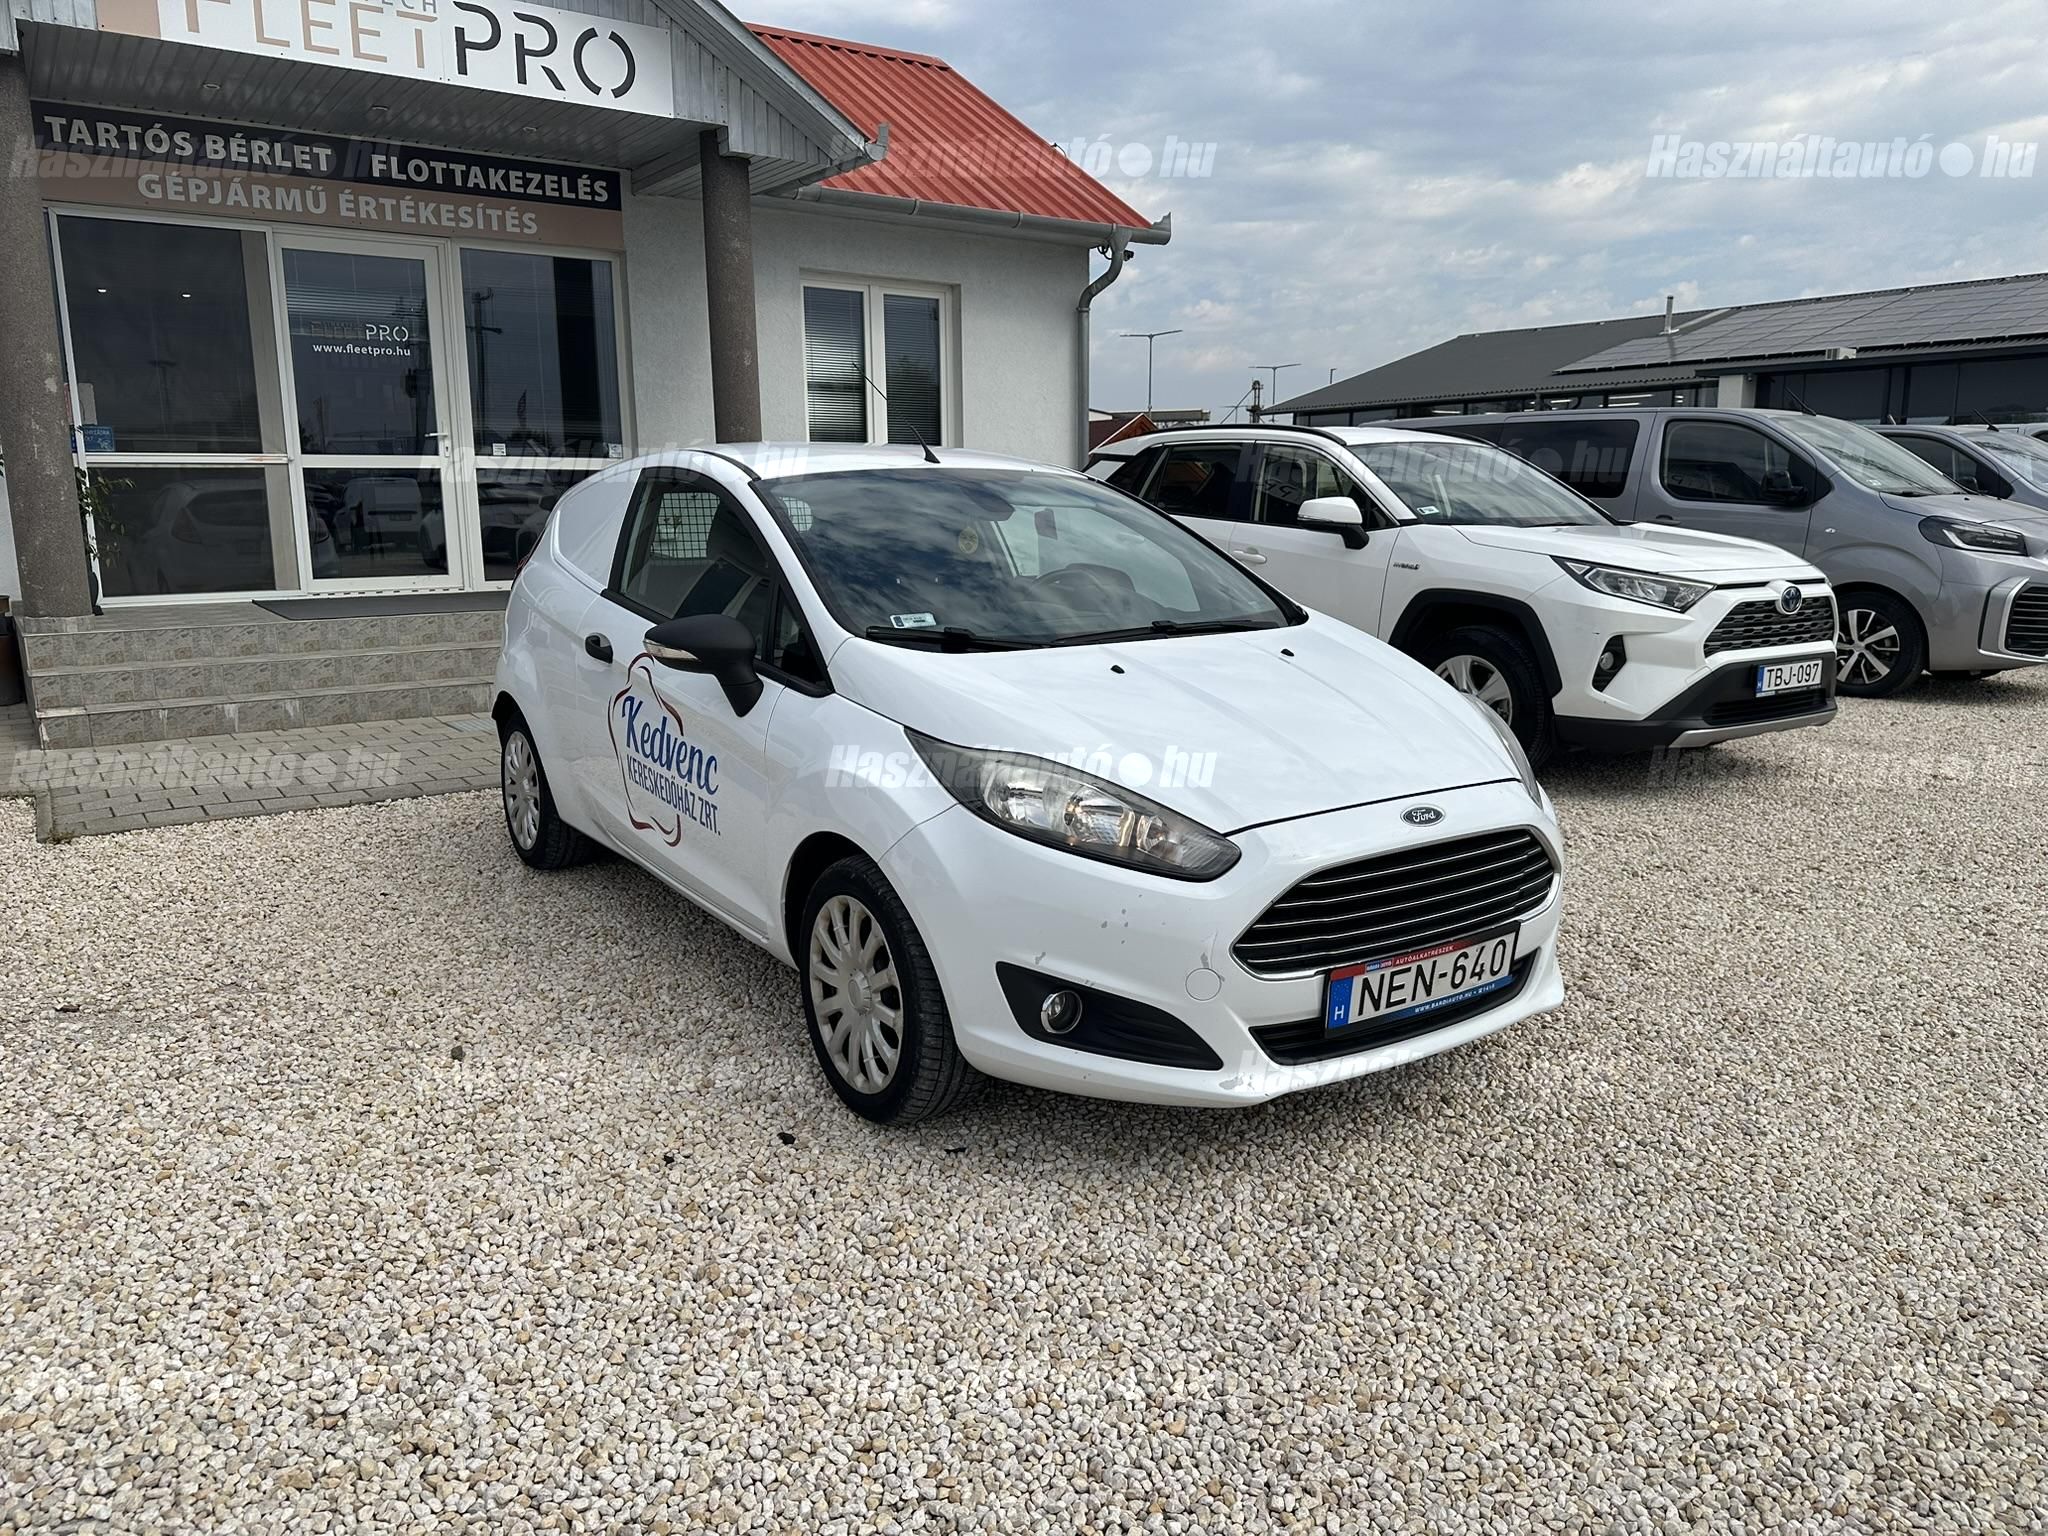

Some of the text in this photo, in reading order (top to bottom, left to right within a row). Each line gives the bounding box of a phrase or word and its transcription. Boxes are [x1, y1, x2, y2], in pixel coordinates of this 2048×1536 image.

[43, 115, 609, 202] TARTÓS BÉRLET FLOTTAKEZELÉS
[138, 171, 538, 235] GÉPJÁRMŰ ÉRTÉKESÍTÉS
[312, 343, 411, 357] www.fleetpro.hu
[1766, 662, 1820, 688] TBJ-097
[621, 695, 719, 796] Kedvenc
[626, 753, 721, 836] KERESKEDŐHÁZ ZRT.
[1411, 808, 1437, 823] Ford
[1334, 938, 1507, 1021] H NEN-640
